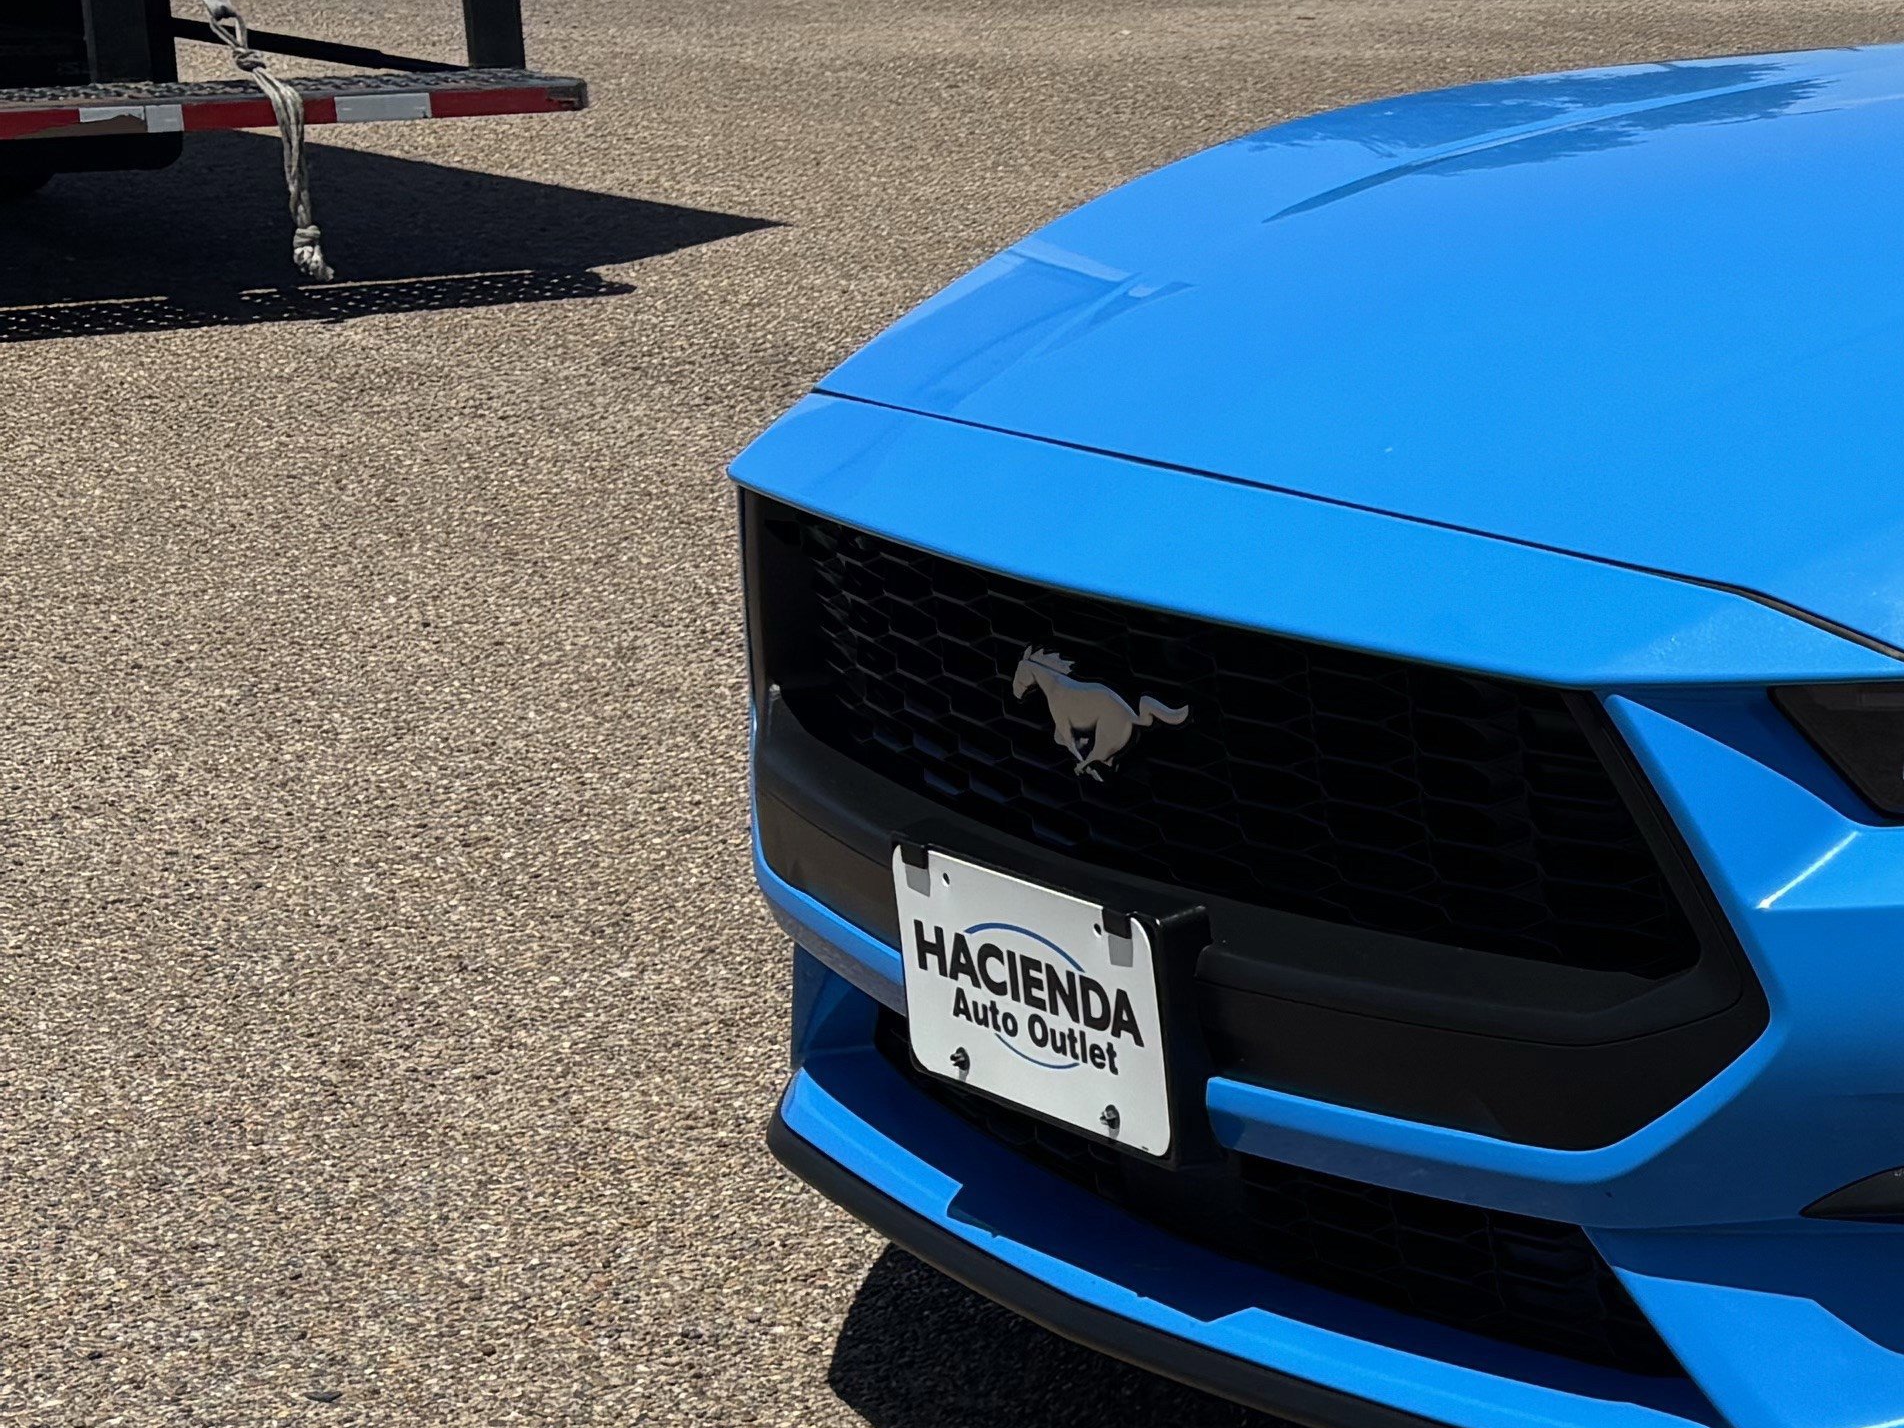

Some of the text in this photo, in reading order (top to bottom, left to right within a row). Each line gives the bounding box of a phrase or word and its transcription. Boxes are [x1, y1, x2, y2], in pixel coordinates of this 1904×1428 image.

[913, 919, 1145, 1048] HACIENDA
[952, 986, 1119, 1075] Auto Outlet
